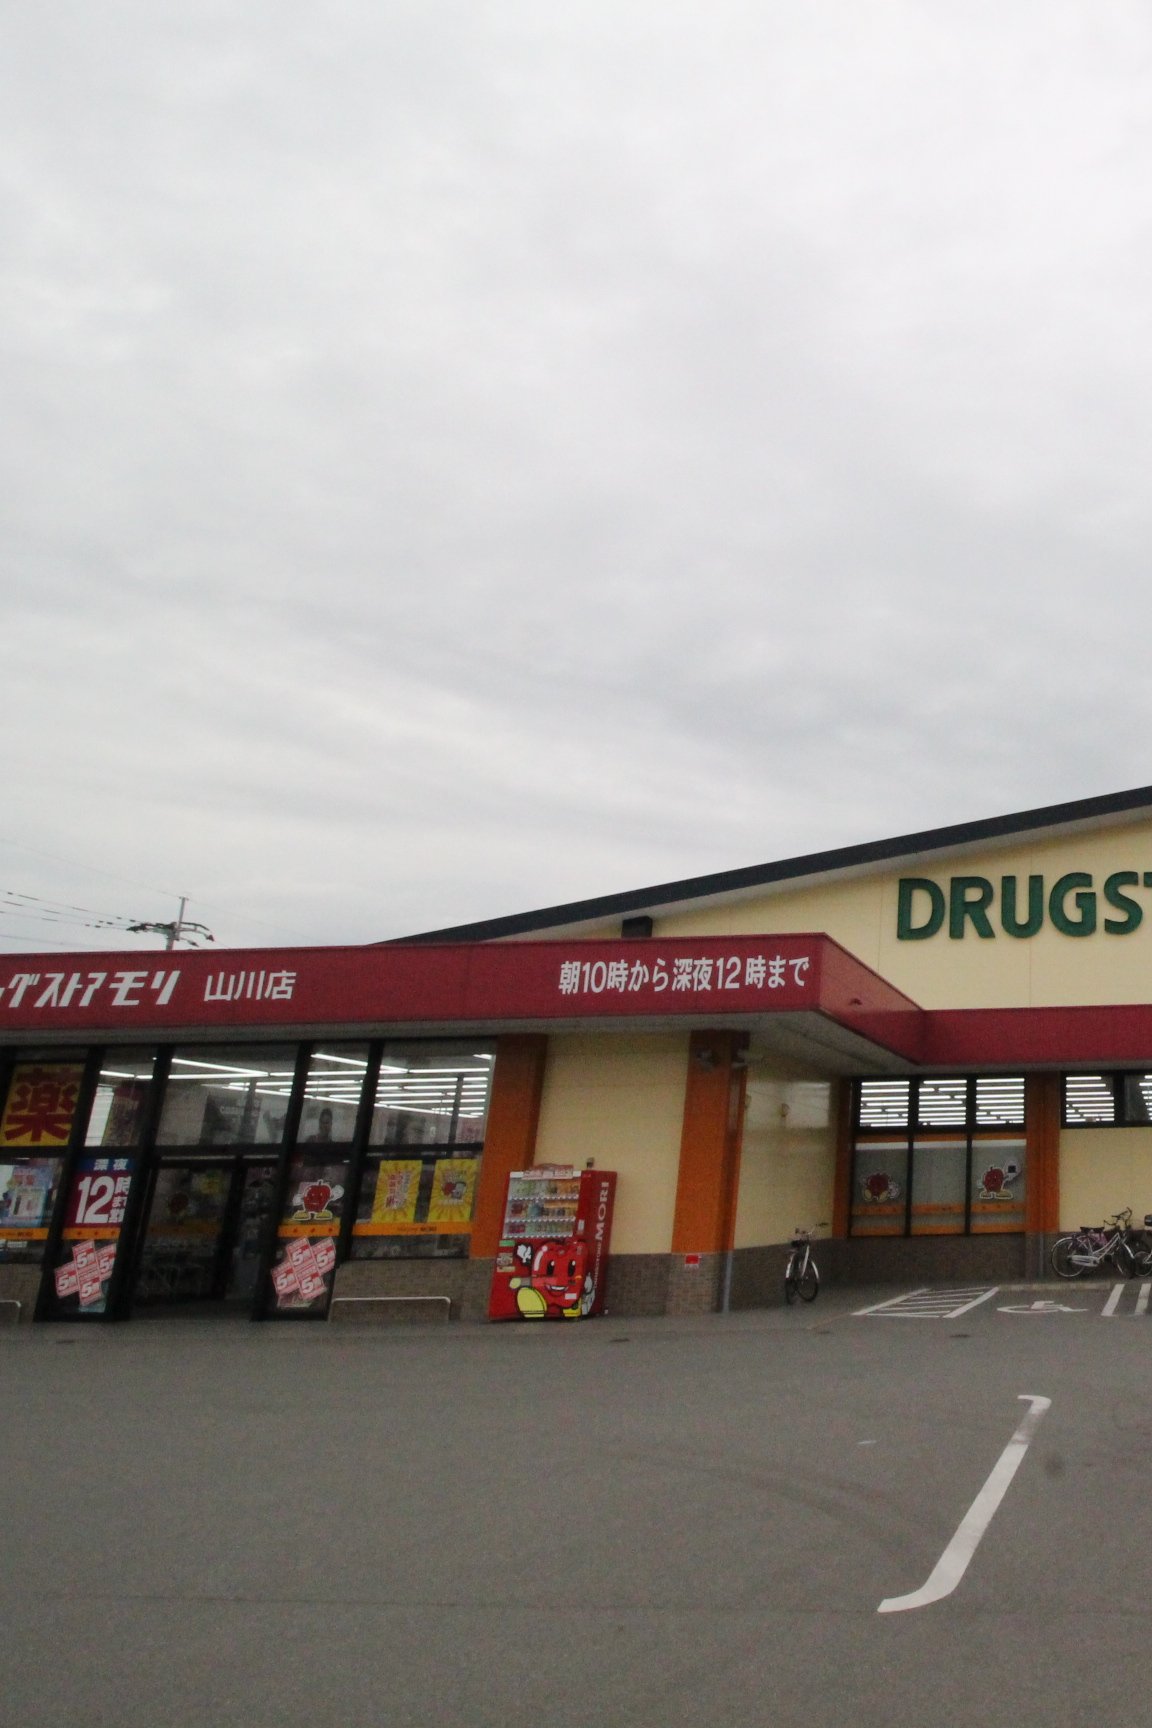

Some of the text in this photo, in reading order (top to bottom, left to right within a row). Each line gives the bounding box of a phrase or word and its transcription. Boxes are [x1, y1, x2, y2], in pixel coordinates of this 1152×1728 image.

[0, 970, 297, 1008] グストアモリ 山川店
[558, 955, 809, 995] 朝10時から深夜12時まで
[75, 1175, 115, 1224] 12
[595, 1181, 609, 1240] MORI
